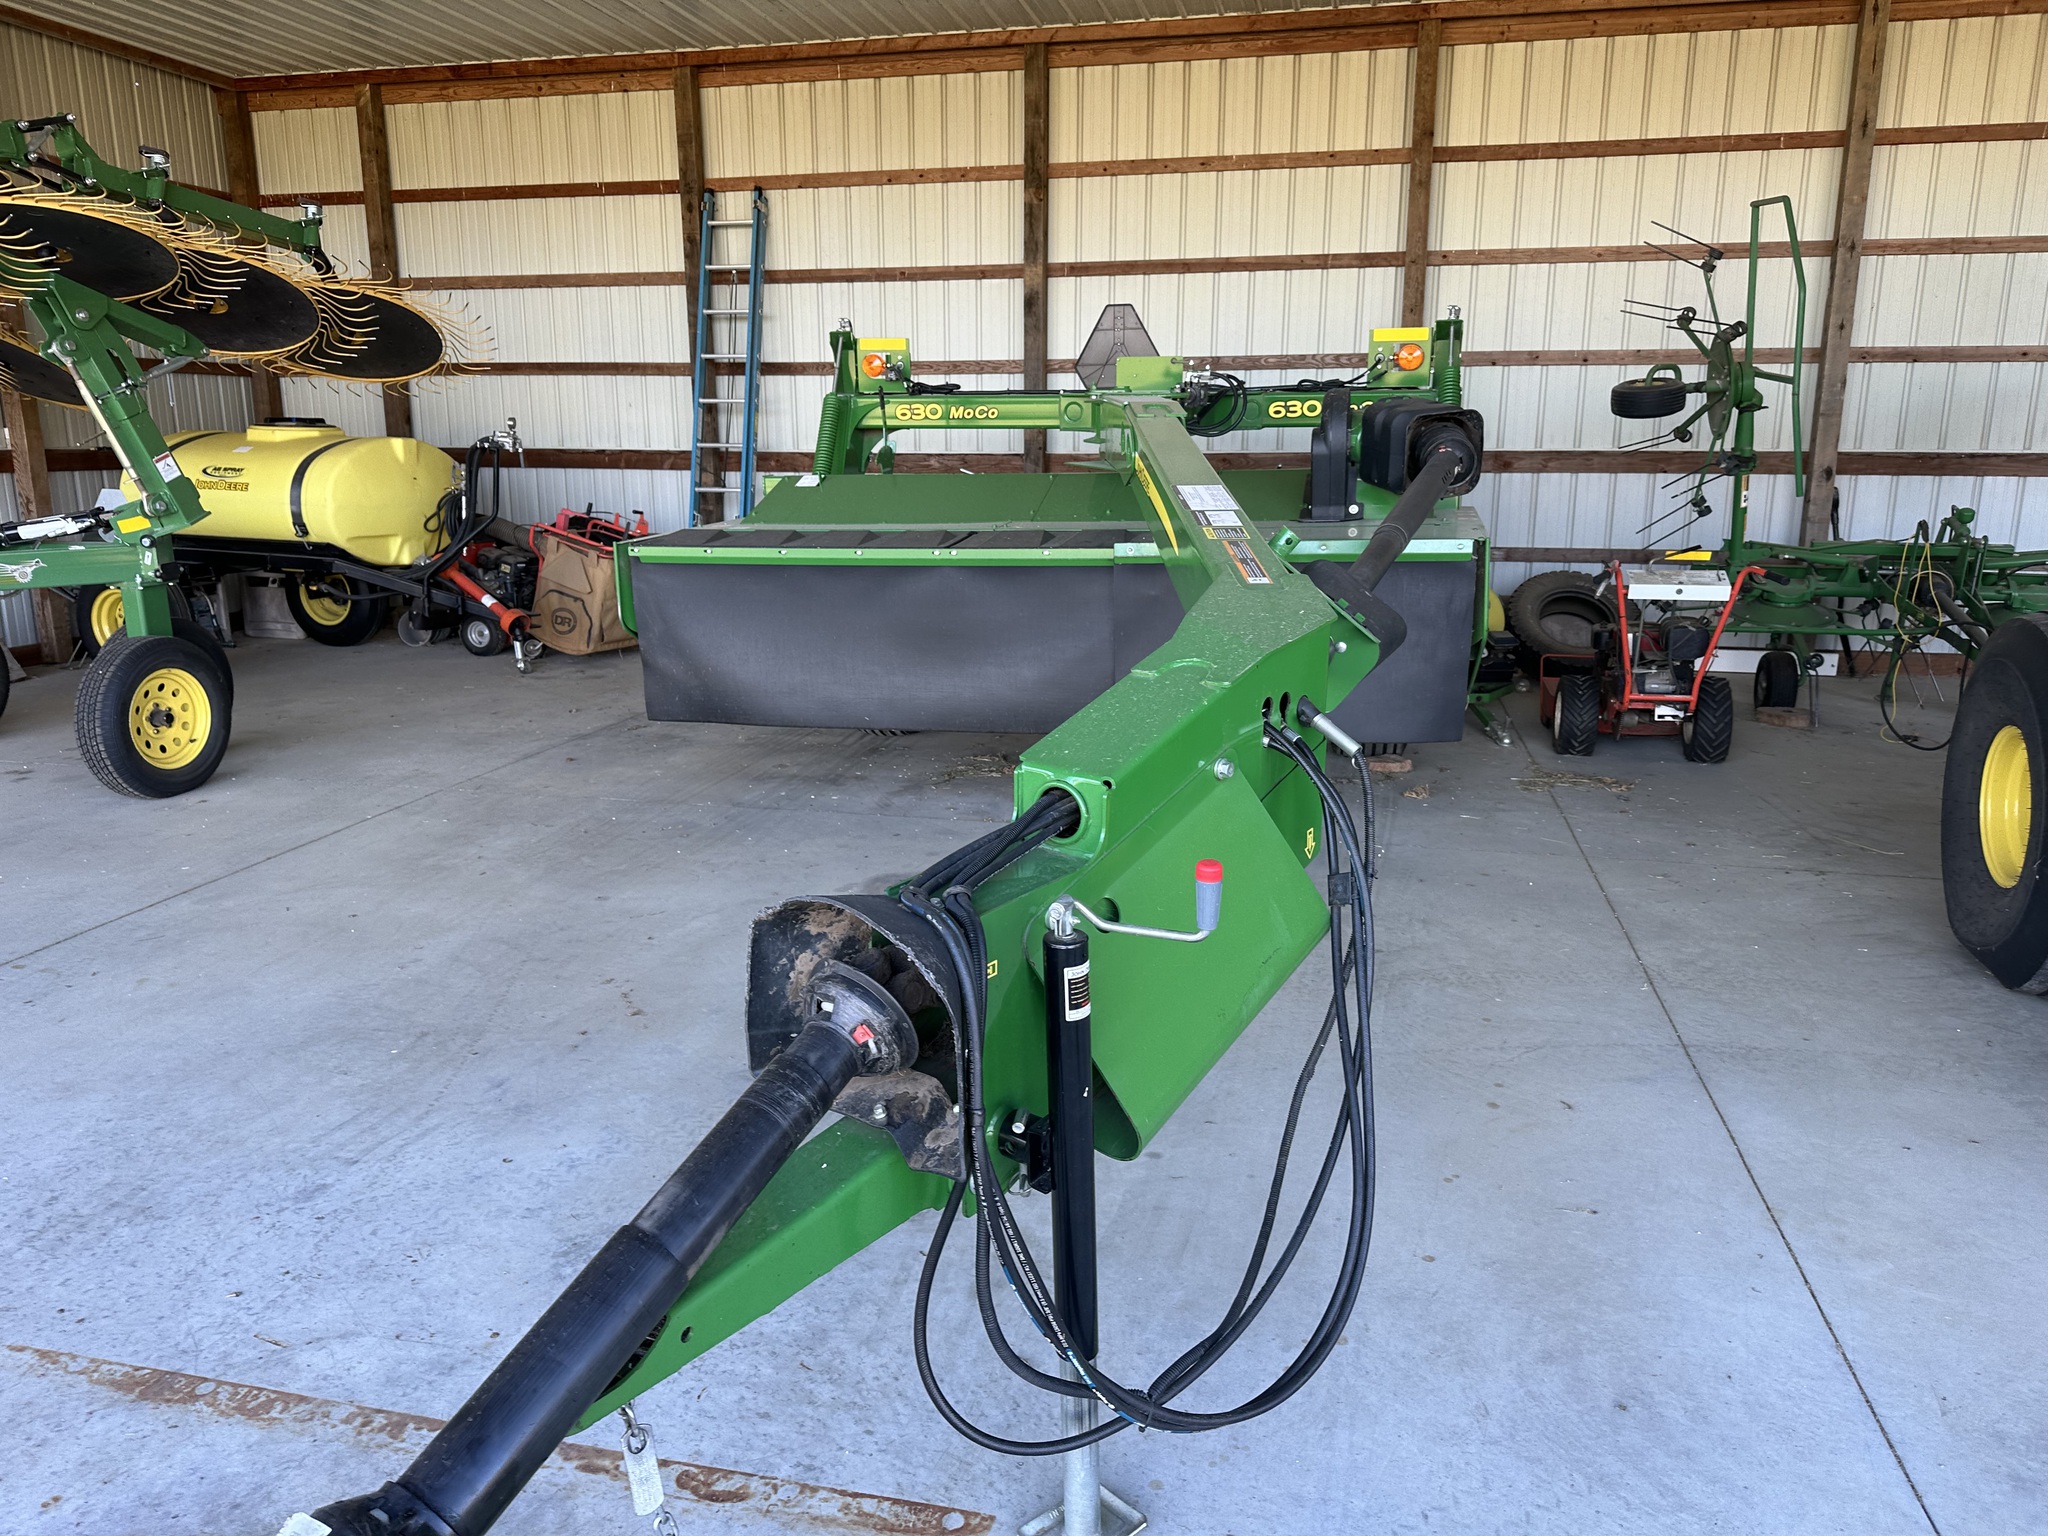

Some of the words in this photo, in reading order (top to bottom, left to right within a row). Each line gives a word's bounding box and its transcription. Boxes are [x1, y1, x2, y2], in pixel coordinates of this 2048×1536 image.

[895, 403, 942, 420] 630
[950, 405, 999, 419] MoCo
[1268, 399, 1322, 418] 630
[217, 479, 249, 492] DEERE
[554, 614, 572, 628] DR
